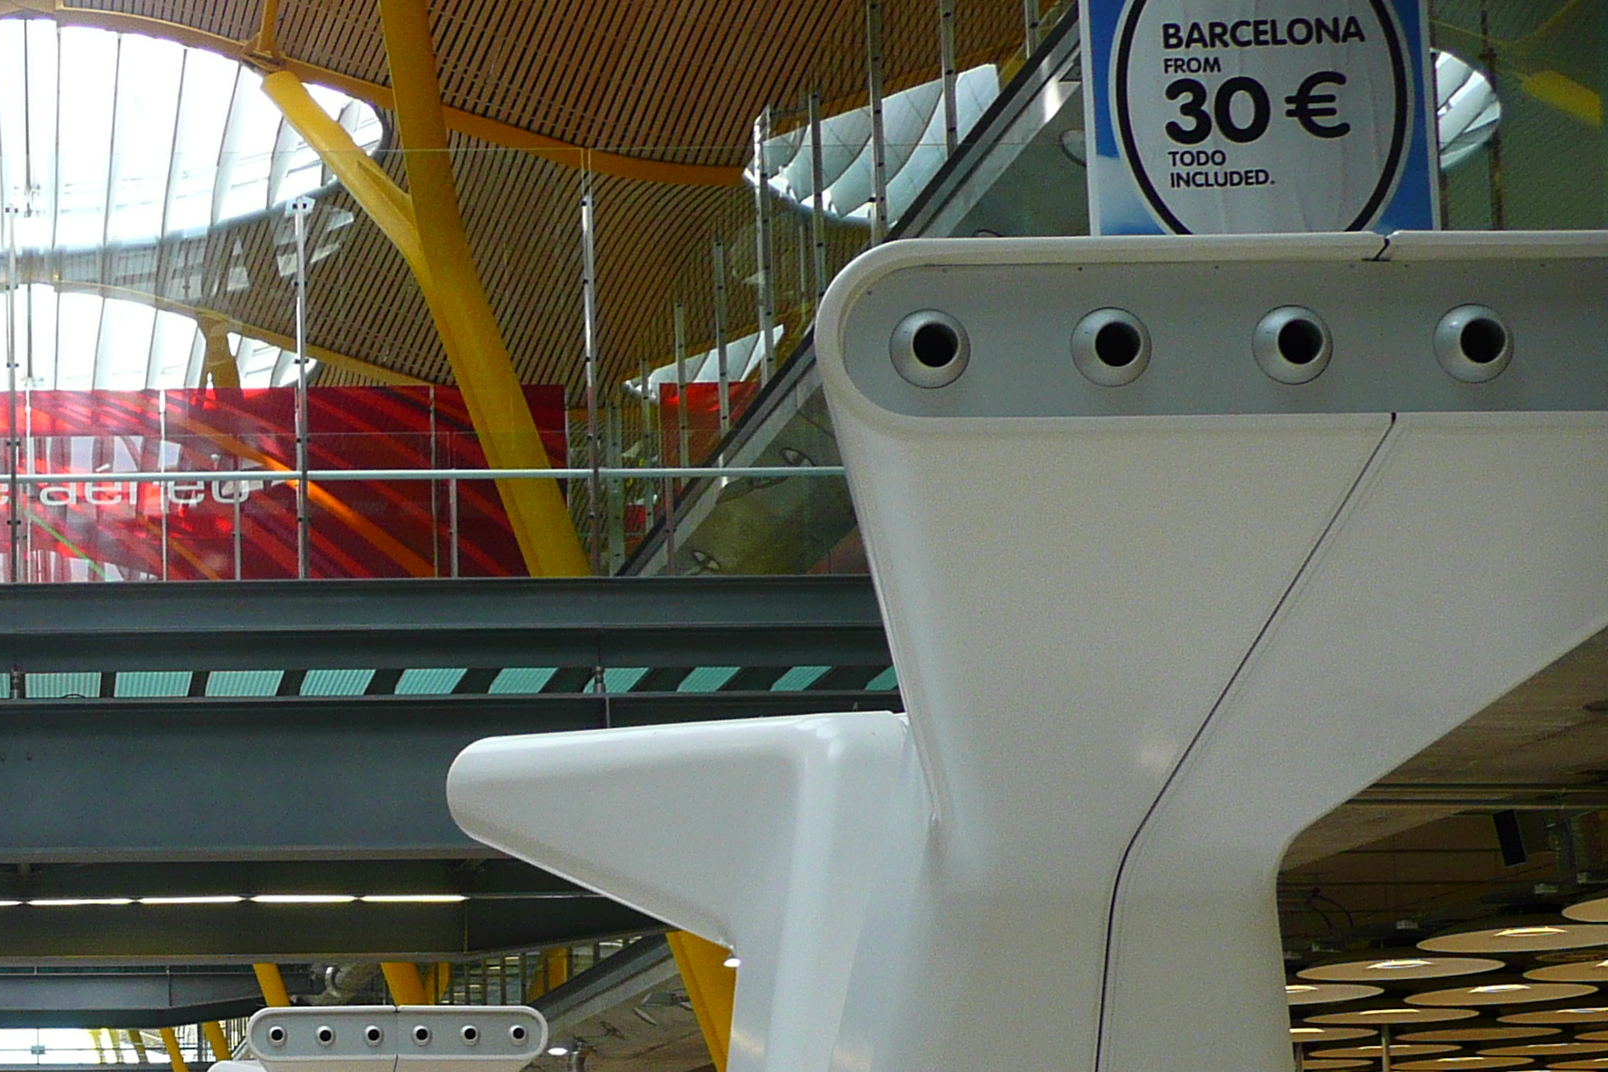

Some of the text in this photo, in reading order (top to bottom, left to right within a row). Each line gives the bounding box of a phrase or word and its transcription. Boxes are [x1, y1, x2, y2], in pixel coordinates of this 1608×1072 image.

[1162, 16, 1366, 50] BARCELONA
[1163, 57, 1222, 74] FROM
[1164, 71, 1351, 145] 30 €
[1168, 149, 1227, 168] TODO
[1169, 168, 1276, 189] INCLUDED.
[39, 463, 250, 506] aéreo
